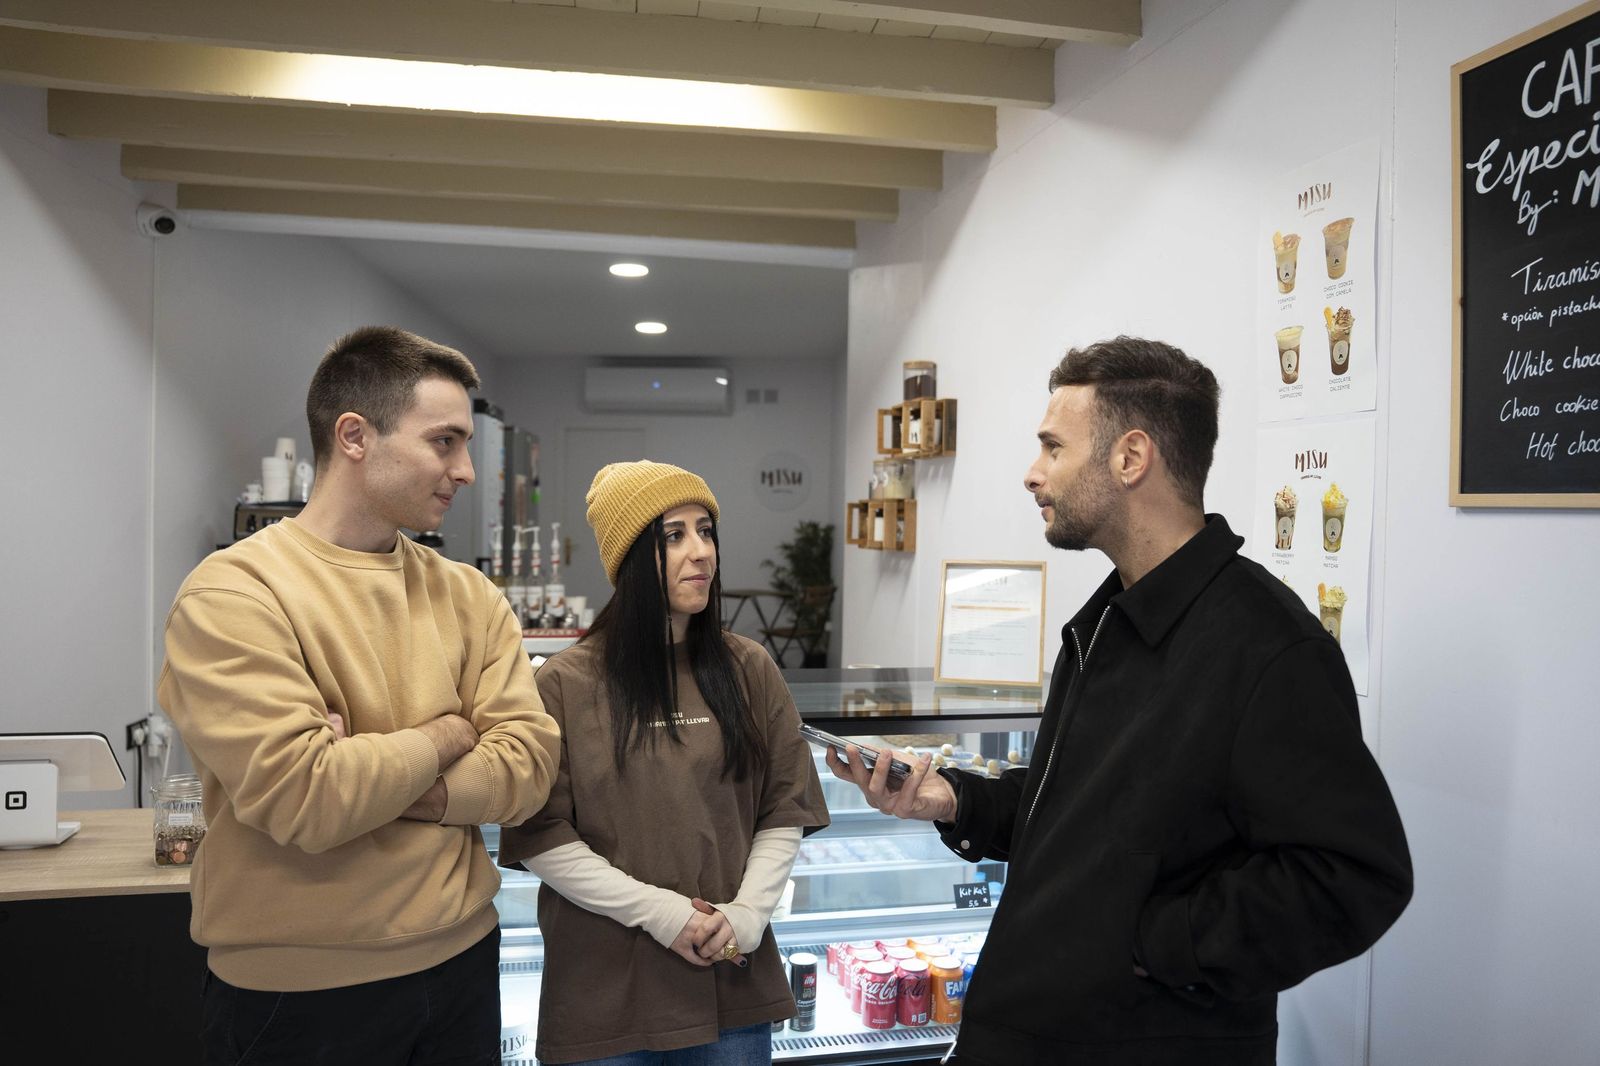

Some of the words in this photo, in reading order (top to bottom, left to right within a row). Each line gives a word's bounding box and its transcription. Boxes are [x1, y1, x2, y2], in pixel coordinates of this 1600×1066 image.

[1298, 182, 1332, 210] MISU
[1503, 350, 1554, 385] White
[1500, 397, 1540, 422] Choco
[1527, 431, 1559, 461] Hot
[1295, 449, 1328, 473] MISU
